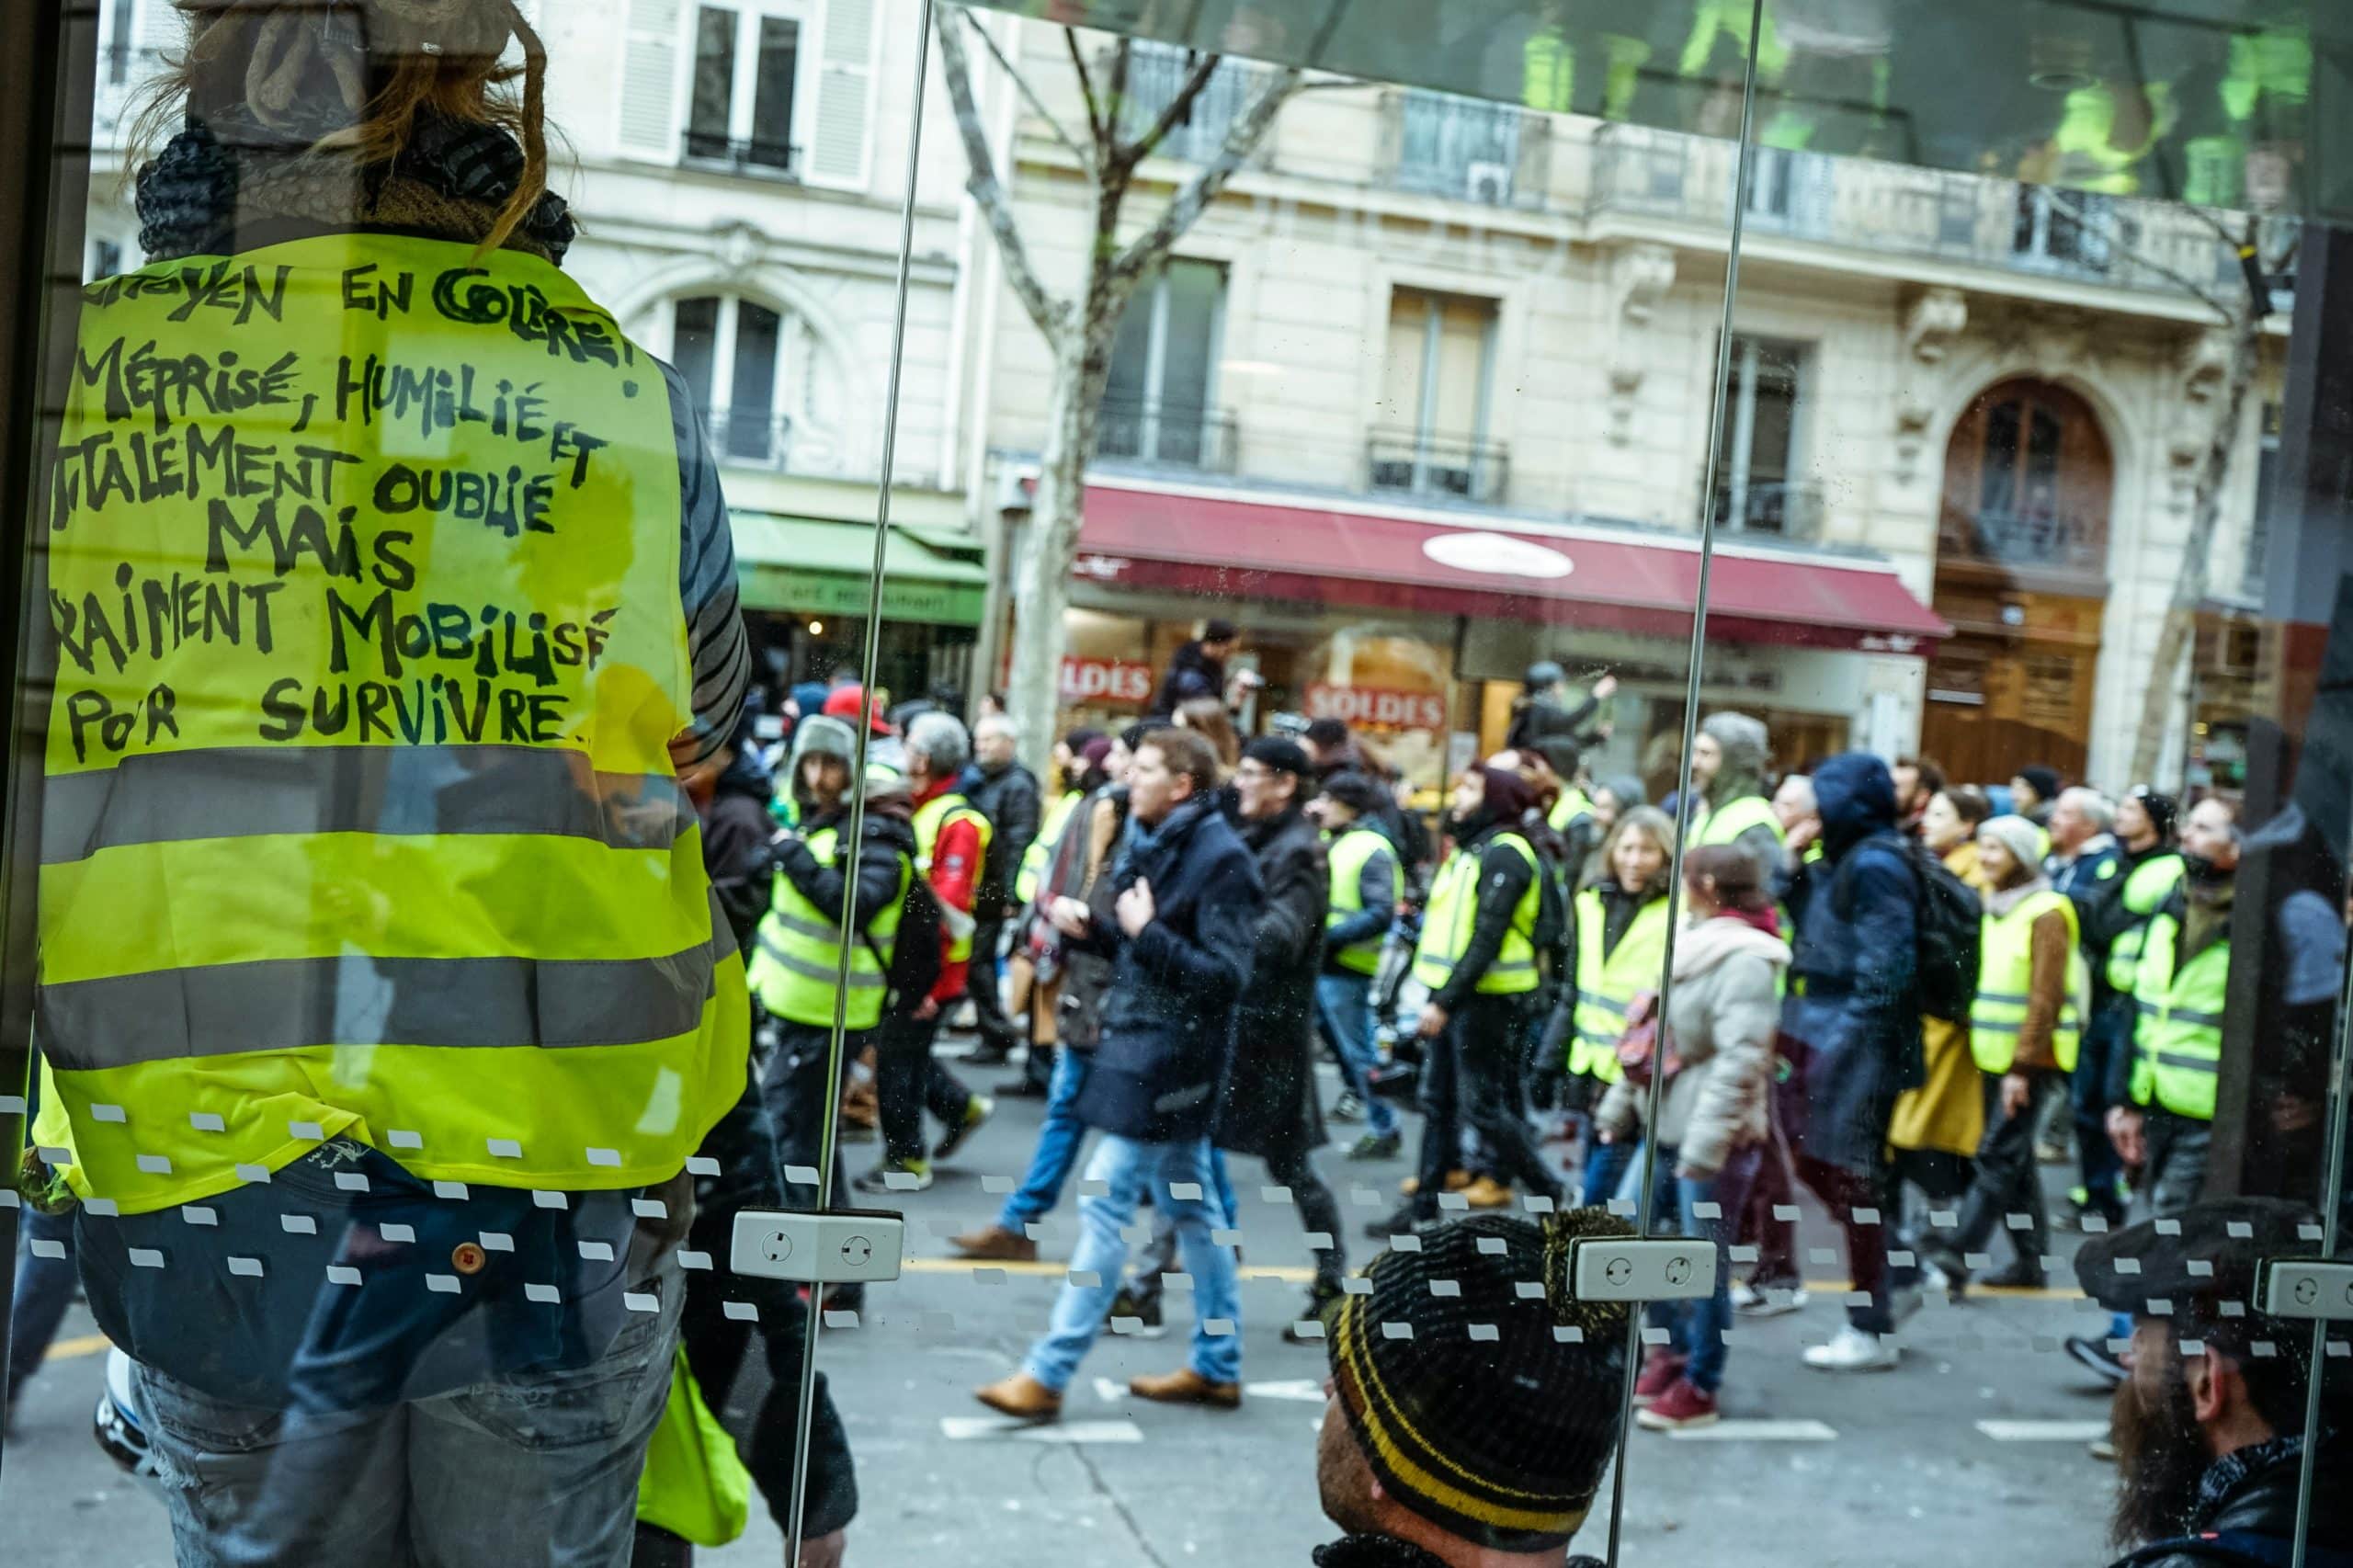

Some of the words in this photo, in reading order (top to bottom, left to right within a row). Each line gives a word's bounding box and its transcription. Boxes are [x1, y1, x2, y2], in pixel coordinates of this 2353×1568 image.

[342, 264, 413, 321] EN
[551, 421, 608, 489] ET
[1062, 662, 1152, 700] LDES
[1308, 687, 1444, 729] SOLDES
